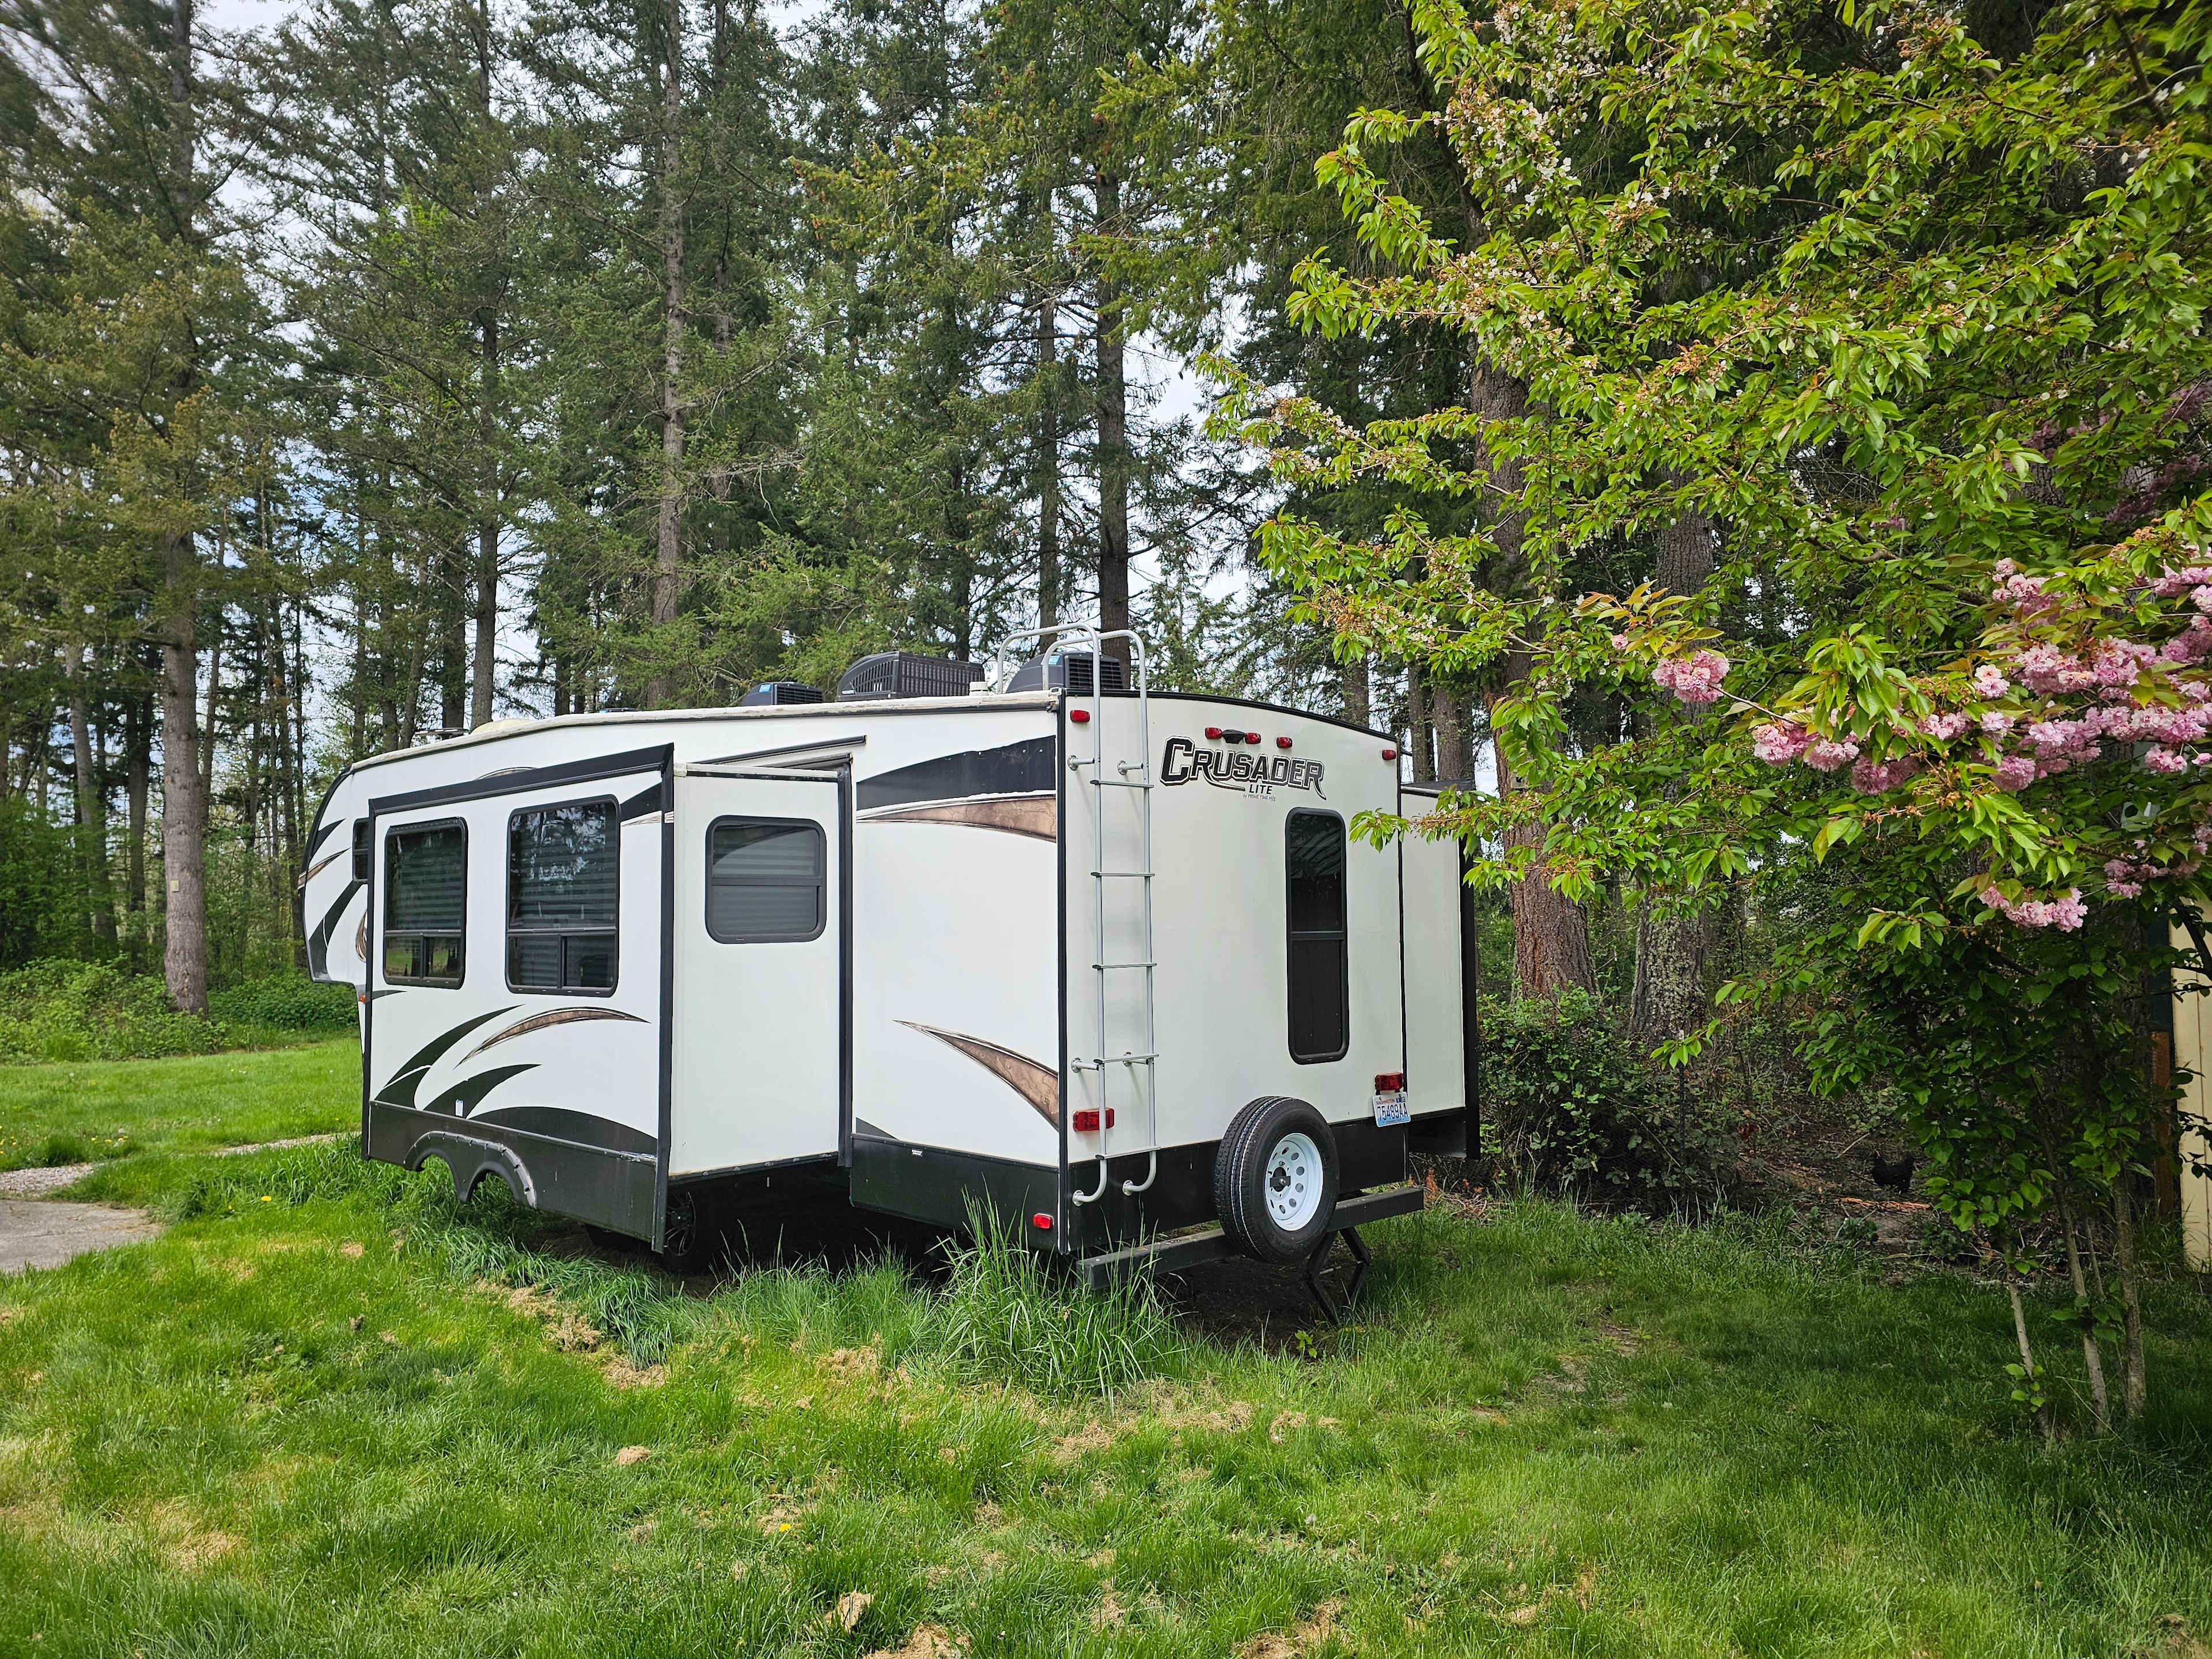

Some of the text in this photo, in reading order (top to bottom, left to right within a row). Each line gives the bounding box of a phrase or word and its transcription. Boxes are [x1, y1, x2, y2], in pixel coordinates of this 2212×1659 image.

[1160, 736, 1327, 800] CRUSADER
[1249, 784, 1272, 794] LITE
[1377, 1103, 1408, 1121] 75489AA
